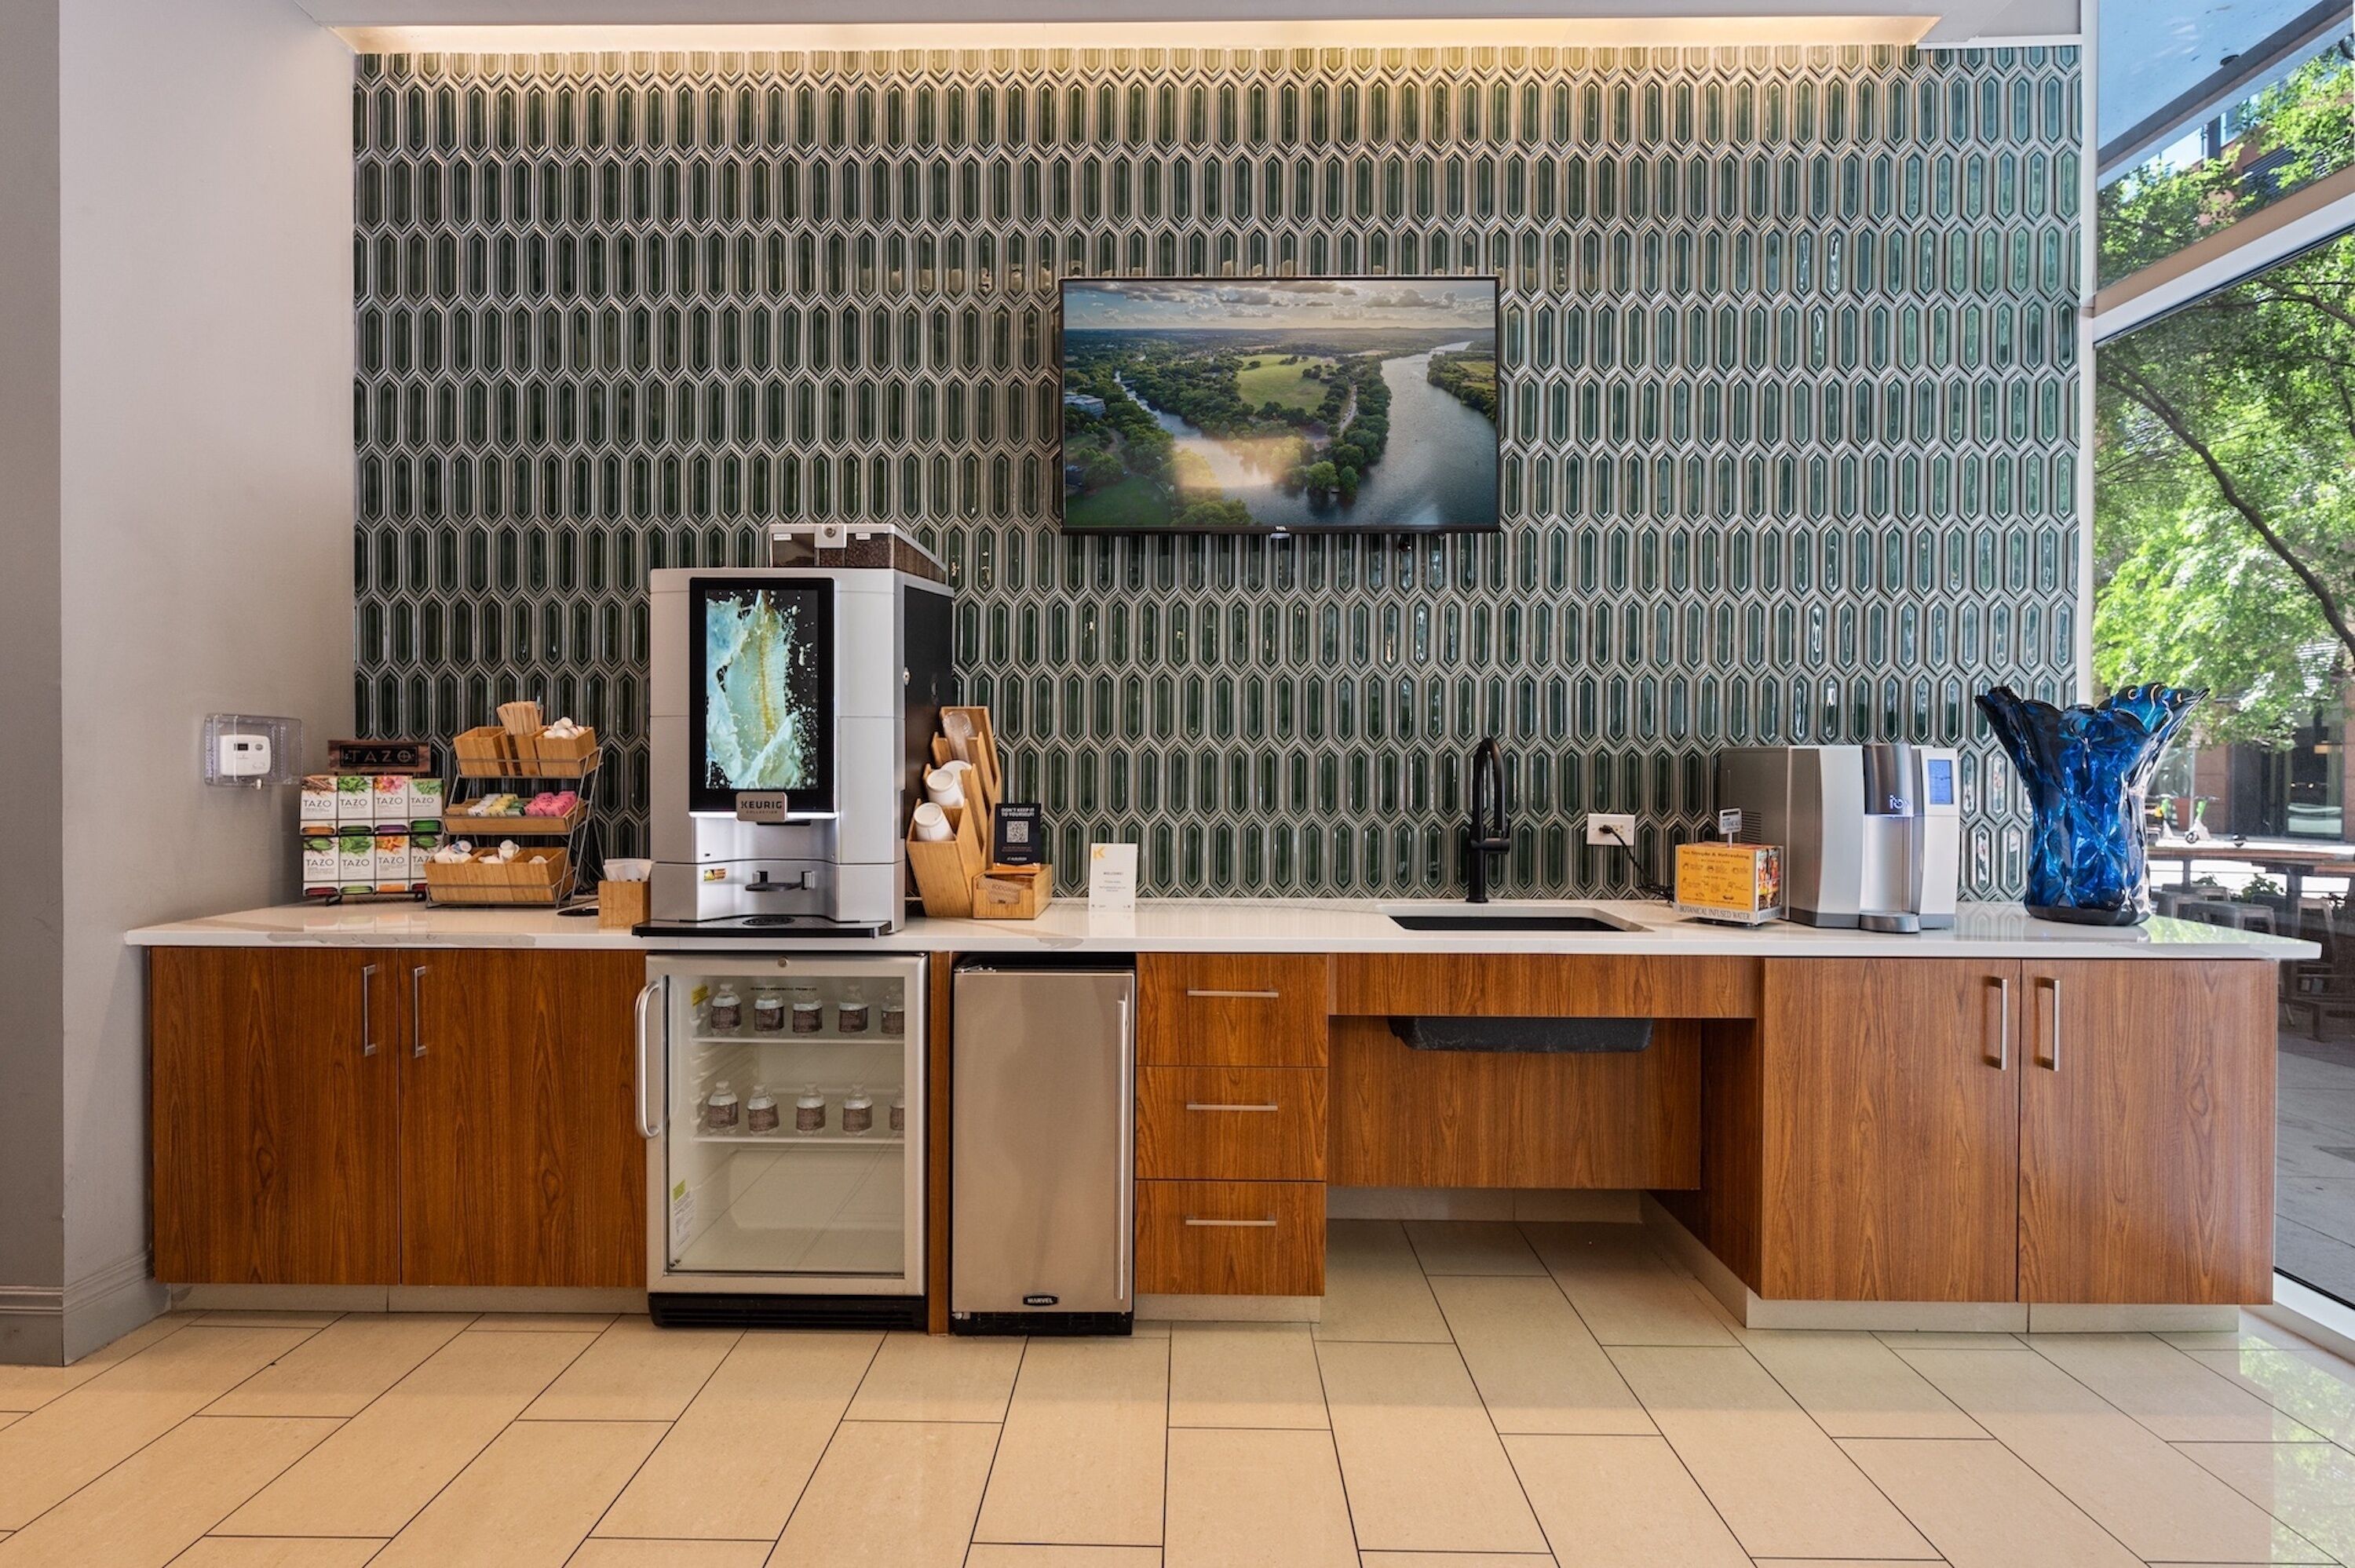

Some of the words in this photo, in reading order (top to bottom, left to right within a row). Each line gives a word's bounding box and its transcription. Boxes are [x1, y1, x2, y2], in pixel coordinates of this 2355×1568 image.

[348, 749, 412, 764] TAZO
[303, 799, 332, 808] TAZO
[340, 798, 367, 807] TAZO
[376, 797, 403, 805] TAZO
[741, 800, 783, 809] KEURIG
[305, 859, 335, 867] TAZO
[342, 859, 371, 867] TAZO
[1679, 905, 1706, 915] BOTANICAL
[1708, 909, 1732, 918] INFUSED
[1733, 912, 1751, 921] WATER
